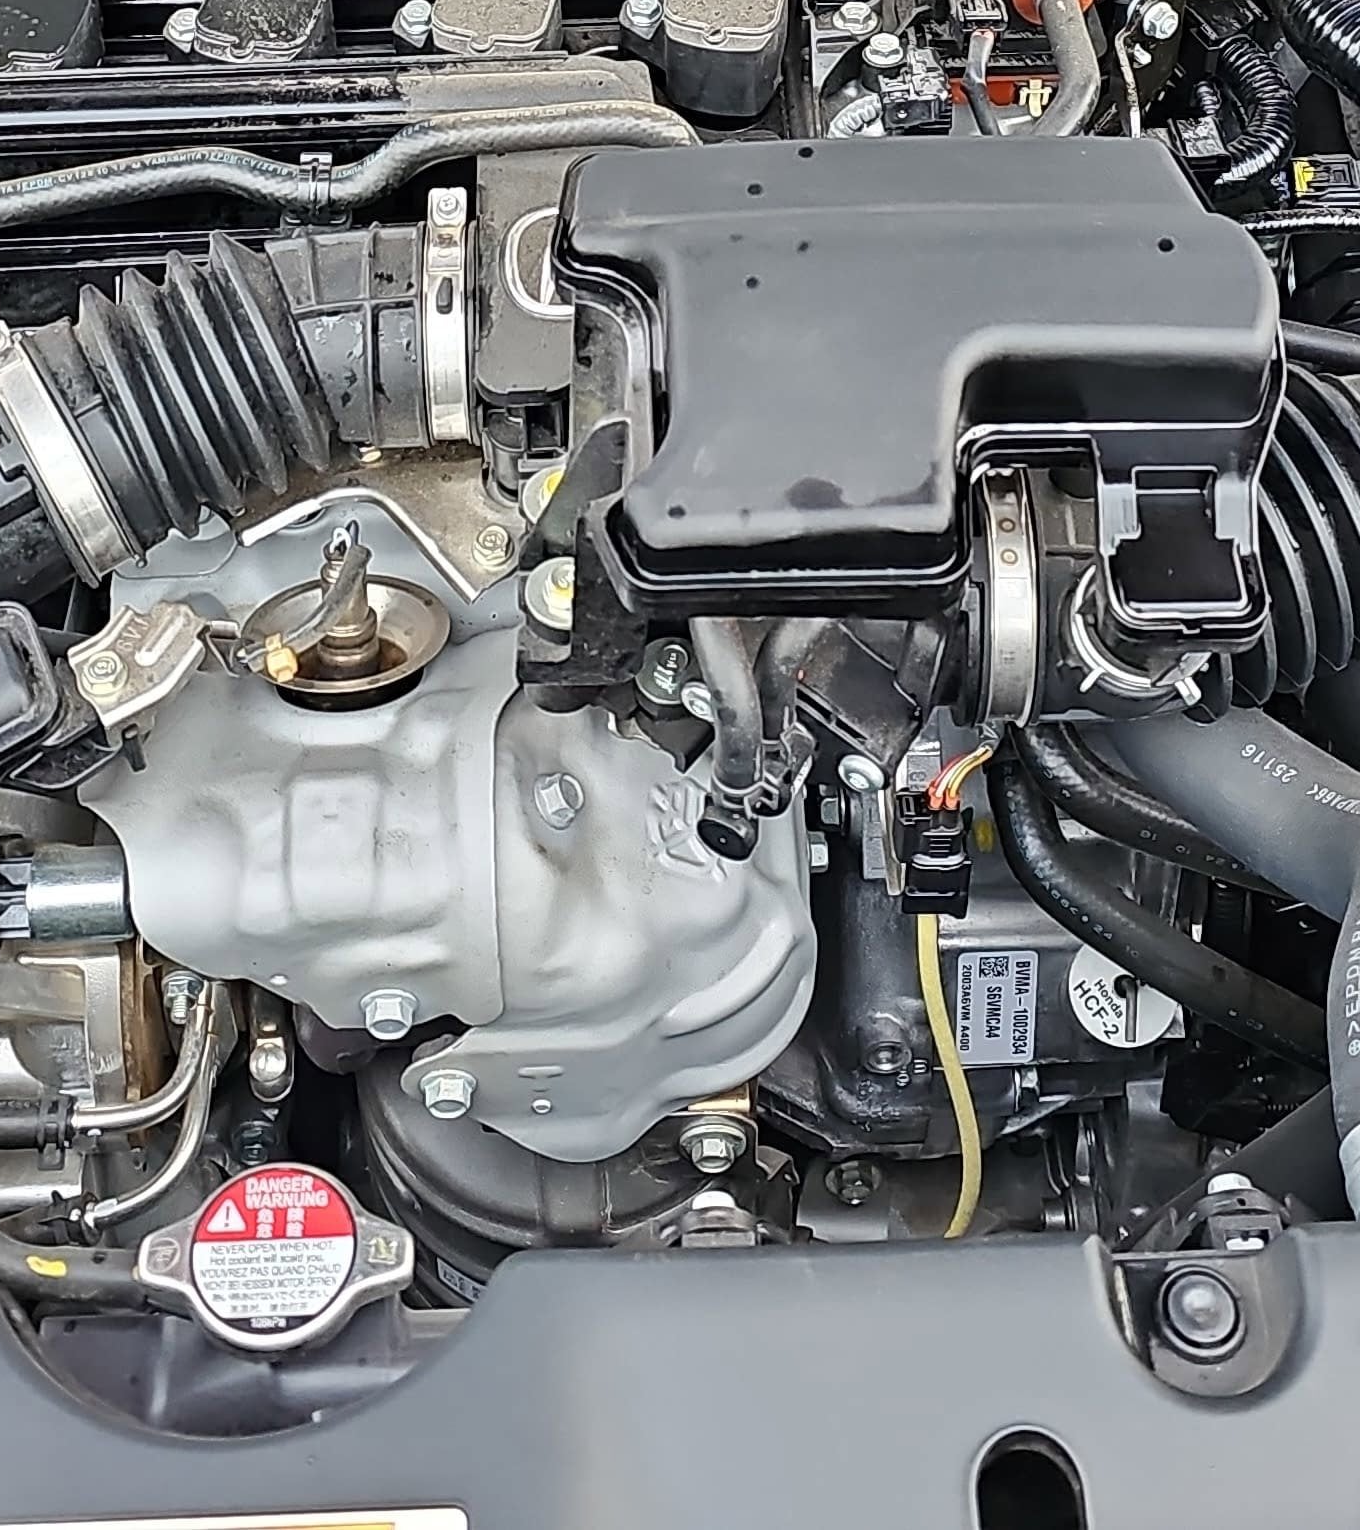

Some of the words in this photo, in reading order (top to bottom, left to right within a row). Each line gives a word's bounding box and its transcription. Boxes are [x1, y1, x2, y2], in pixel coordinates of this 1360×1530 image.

[1241, 743, 1299, 783] 25116
[985, 985, 1003, 1039] S6VMCA4
[1011, 960, 1031, 1055] BVMA-1002934
[1072, 979, 1121, 1039] HCF-2
[1093, 977, 1124, 1020] Honda
[245, 1176, 314, 1193] DANGER
[245, 1189, 329, 1209] WARNUNG
[210, 1244, 246, 1255] NEVER
[248, 1243, 277, 1253] OPEN
[279, 1242, 310, 1252] WHEN
[210, 1255, 226, 1266] Hot
[263, 1254, 277, 1263] will
[250, 1266, 269, 1277] PAS
[272, 1265, 306, 1276] QUAND
[308, 1263, 342, 1275] CHAUD
